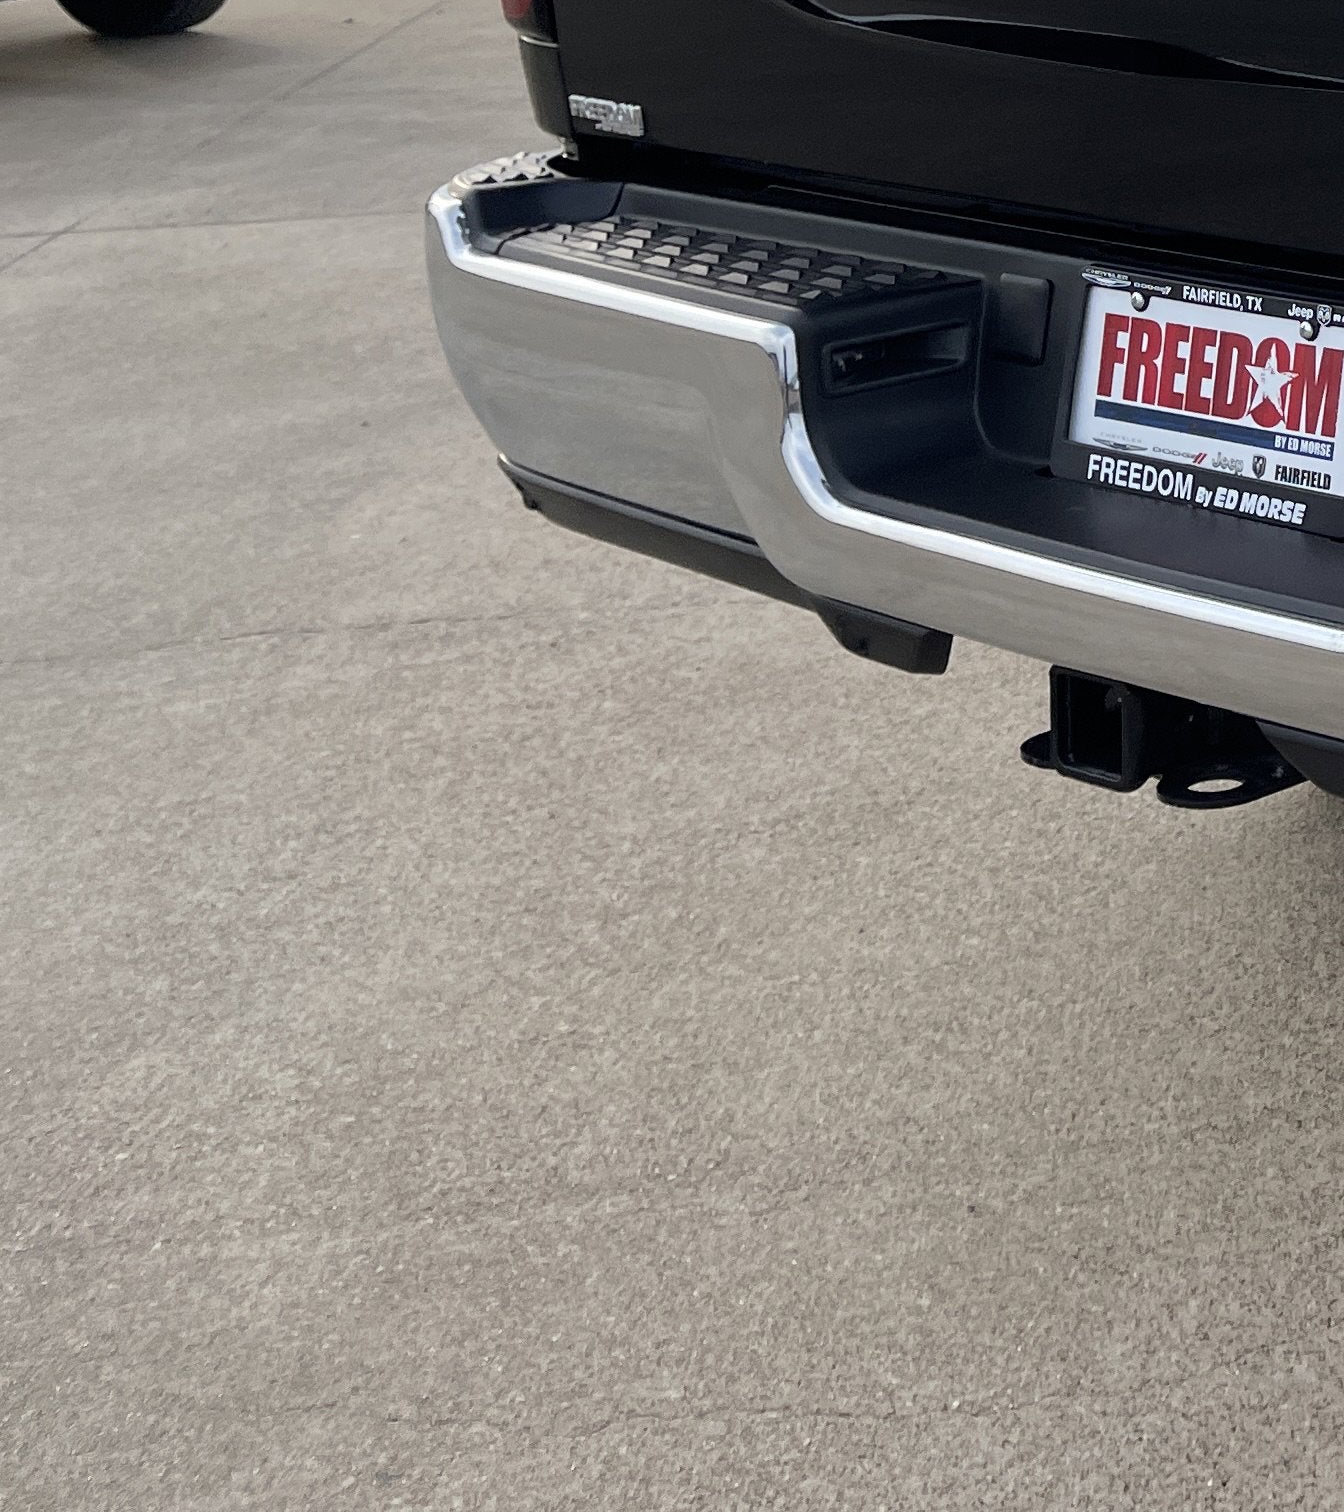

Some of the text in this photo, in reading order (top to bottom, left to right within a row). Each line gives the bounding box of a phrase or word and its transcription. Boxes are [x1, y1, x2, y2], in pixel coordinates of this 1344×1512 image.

[1183, 285, 1263, 312] FAIRFIELD, TX
[1287, 303, 1314, 321] Jeep
[1097, 312, 1344, 438] FREEDOM
[1274, 434, 1332, 458] BY ED MORSE
[1211, 451, 1244, 476] Jeep
[1274, 463, 1332, 491] FAIRFIELD
[1087, 453, 1194, 501] FREEDOM
[1213, 486, 1239, 511] ED
[1239, 491, 1307, 526] MORSE
